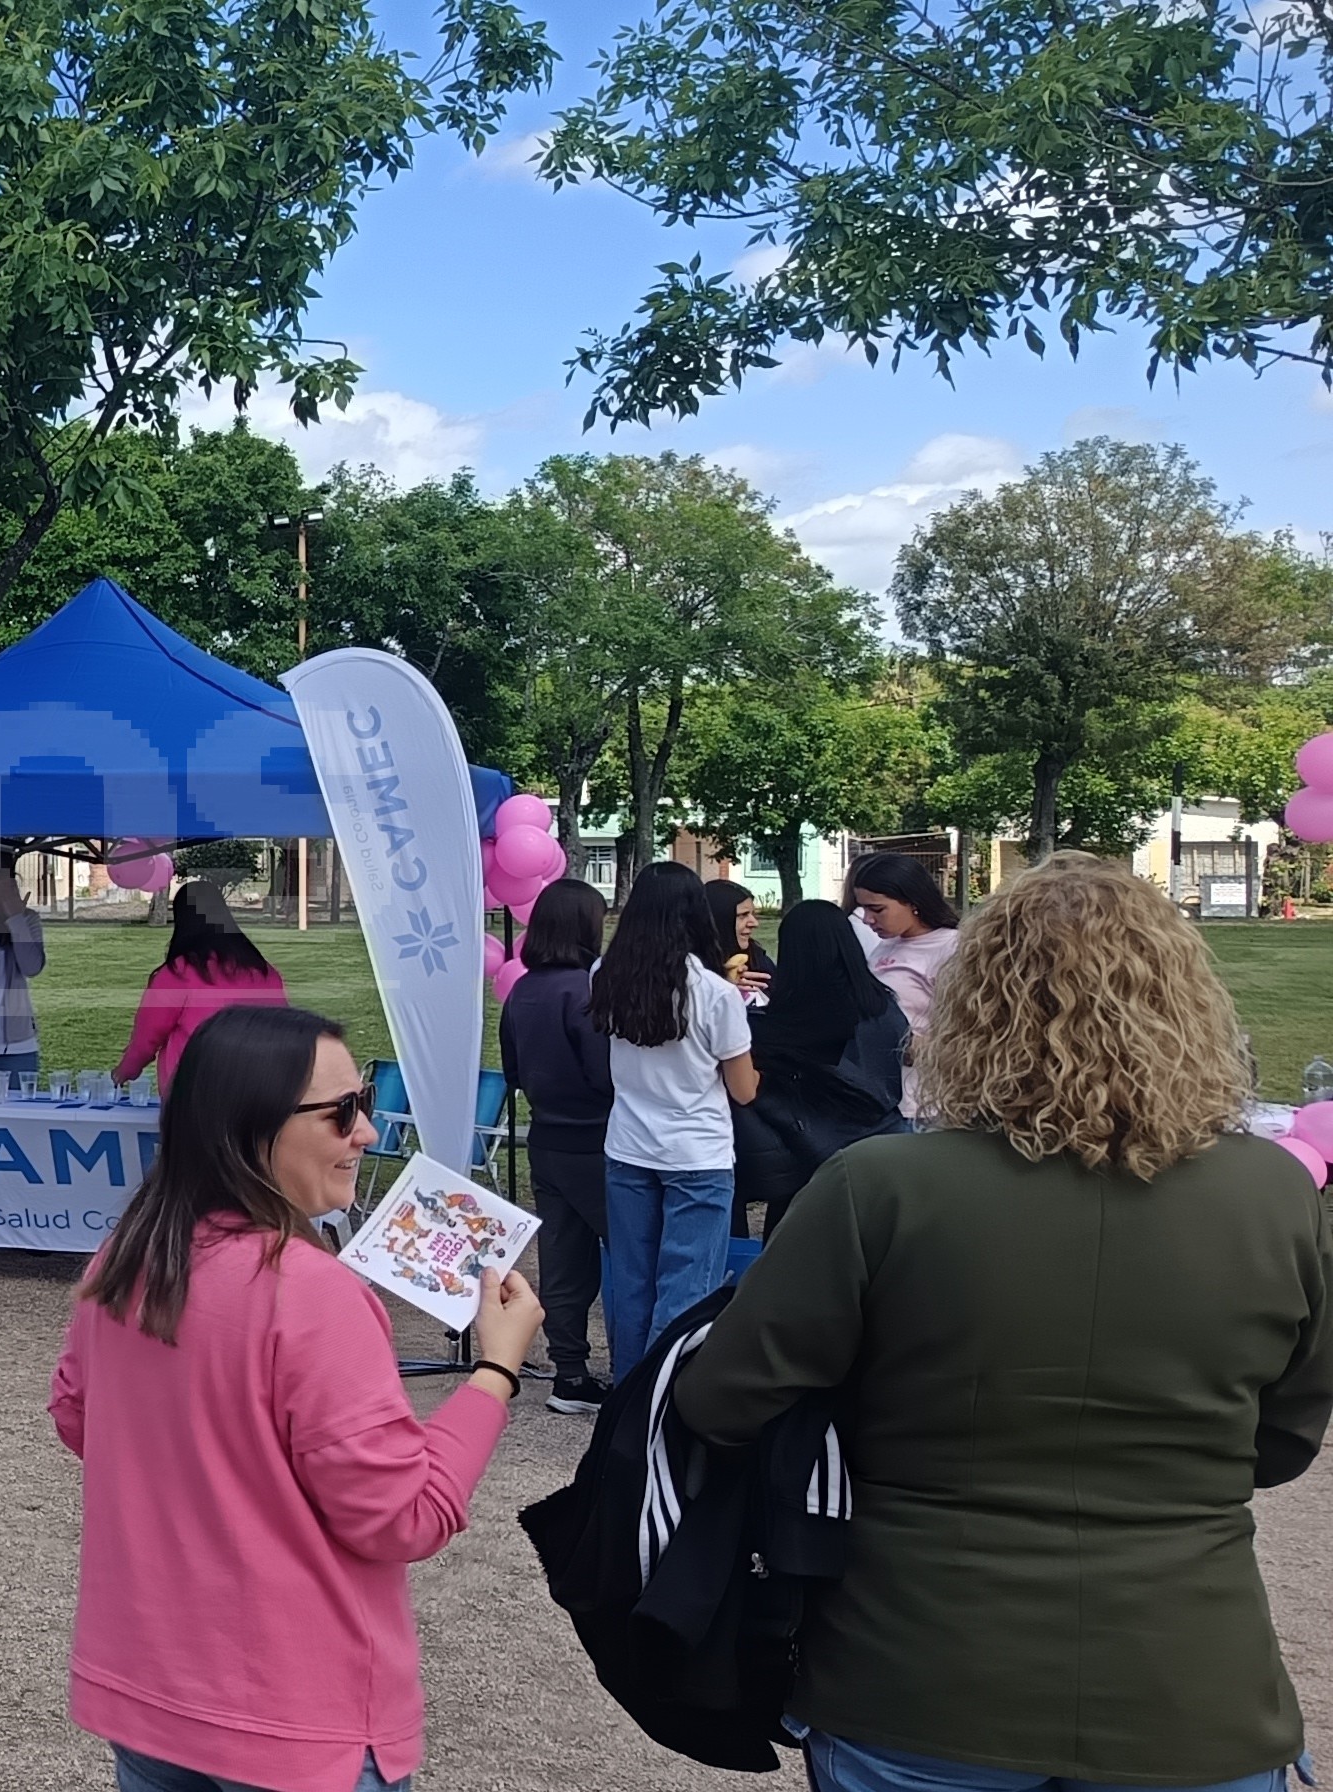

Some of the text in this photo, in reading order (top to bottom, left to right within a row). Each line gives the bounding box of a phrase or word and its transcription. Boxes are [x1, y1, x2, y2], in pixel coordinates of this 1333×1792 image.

[431, 1231, 459, 1263] Y CADA
[441, 1237, 467, 1268] TODAS
